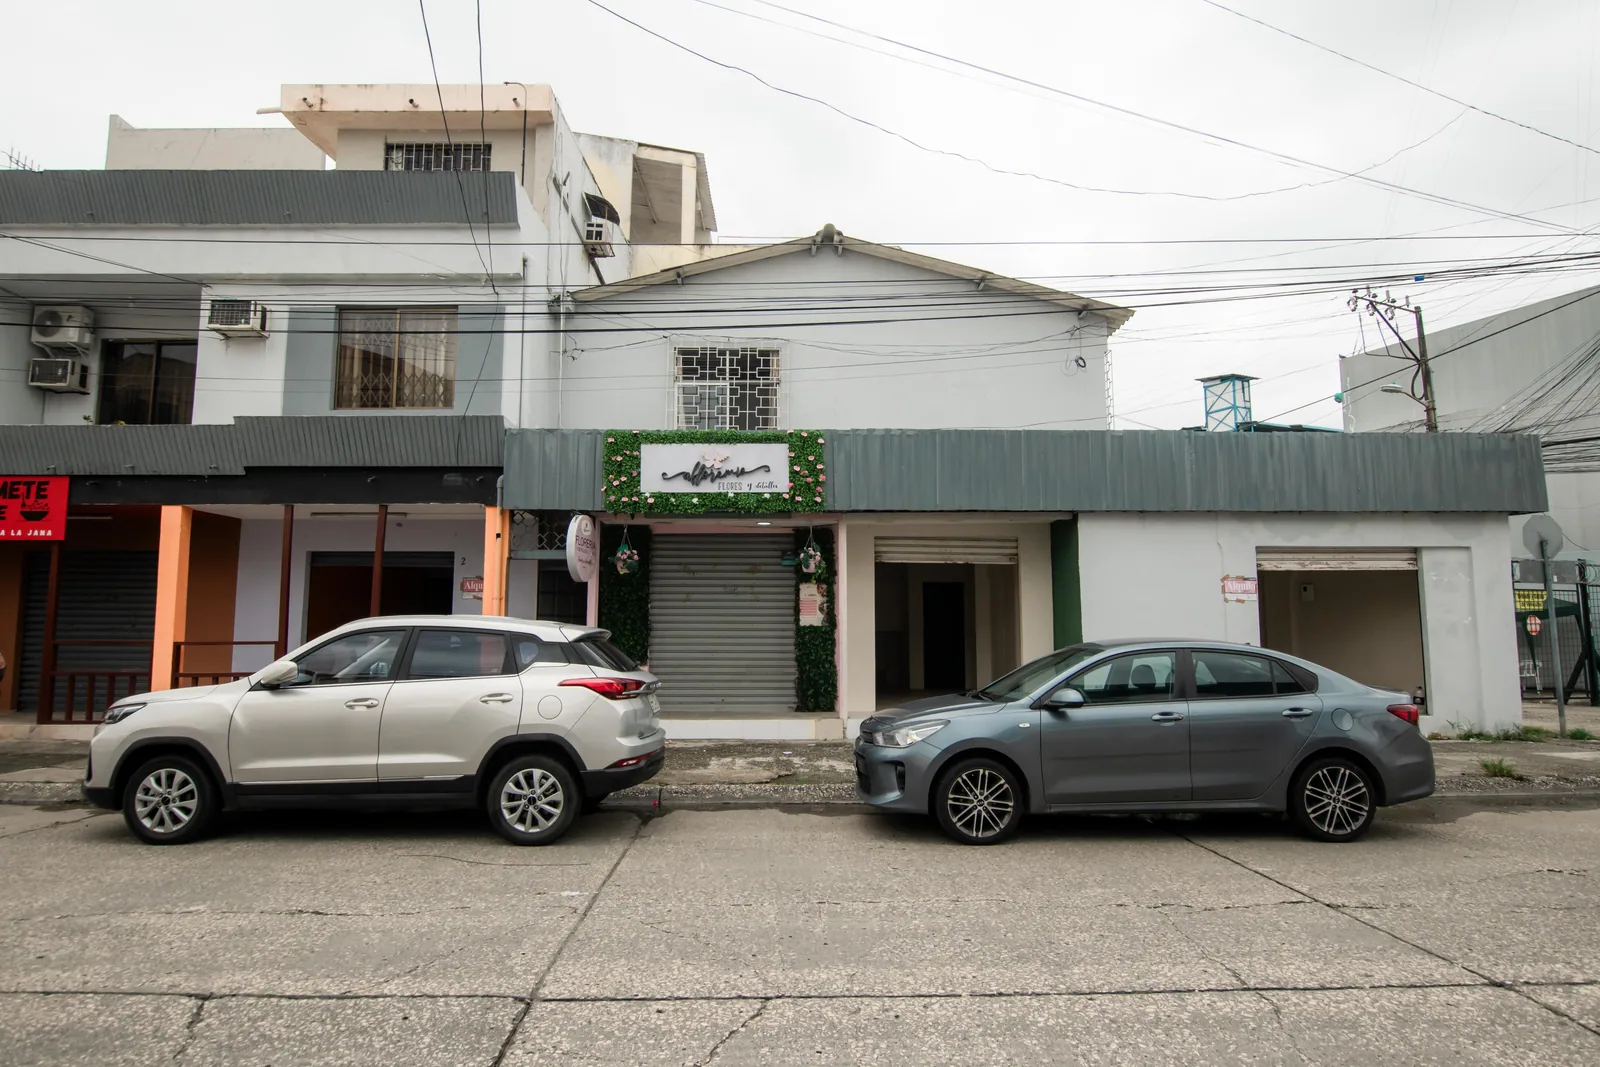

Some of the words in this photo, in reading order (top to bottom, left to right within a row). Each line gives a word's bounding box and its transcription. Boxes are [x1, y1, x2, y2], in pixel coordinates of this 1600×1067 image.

[717, 481, 743, 490] FLORES
[747, 483, 752, 491] y
[461, 557, 466, 565] 2
[464, 580, 483, 592] Alqu
